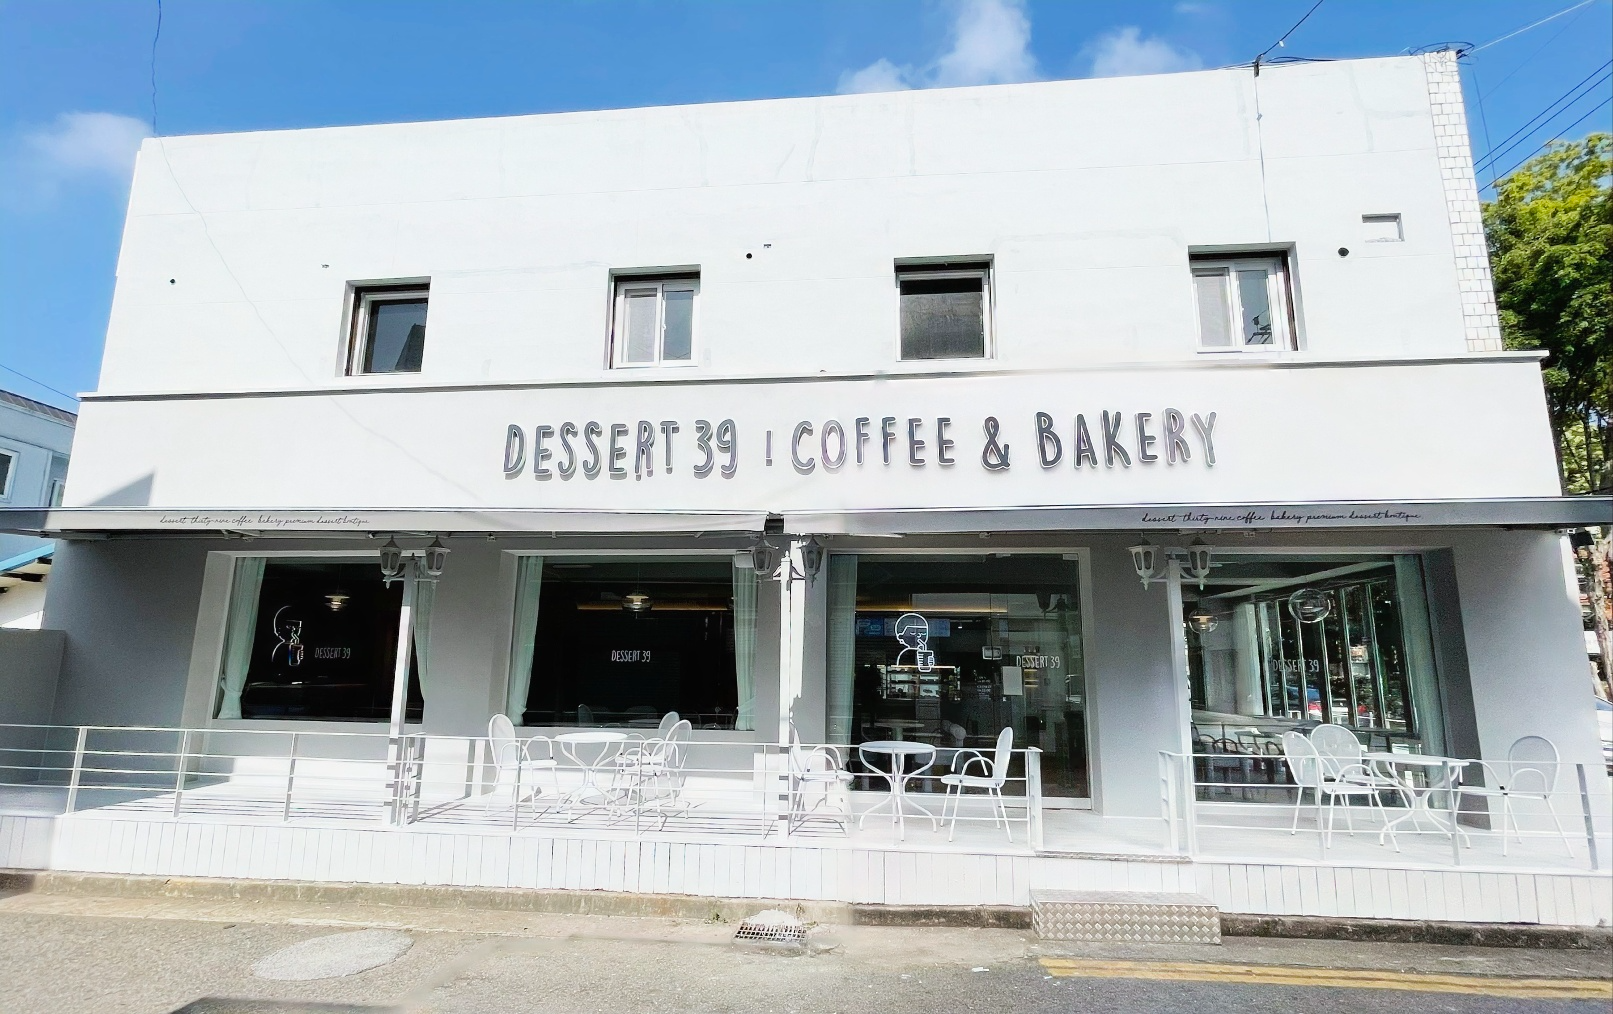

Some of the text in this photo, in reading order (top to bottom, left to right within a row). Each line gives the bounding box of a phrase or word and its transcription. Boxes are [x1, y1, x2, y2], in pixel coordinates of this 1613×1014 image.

[503, 420, 680, 479] DESSERT
[692, 417, 738, 479] 39
[791, 416, 956, 474] COFFEE
[981, 415, 1011, 472] &
[1034, 407, 1217, 469] BAKERY
[159, 515, 187, 524] dessert
[232, 515, 253, 527] coffee
[283, 518, 315, 527] premium
[316, 515, 342, 524] dessert
[343, 515, 370, 527] boutique
[1142, 512, 1178, 523] dessert
[1237, 511, 1266, 524] coffee
[1271, 510, 1304, 524] bakery
[1306, 513, 1346, 523] premium
[1349, 510, 1383, 520] dessert
[1384, 509, 1422, 522] boutique
[314, 646, 351, 660] DESSERT 39
[611, 650, 651, 662] DESSERT 39
[1016, 655, 1060, 669] DESSERT 39
[1308, 659, 1319, 672] 39
